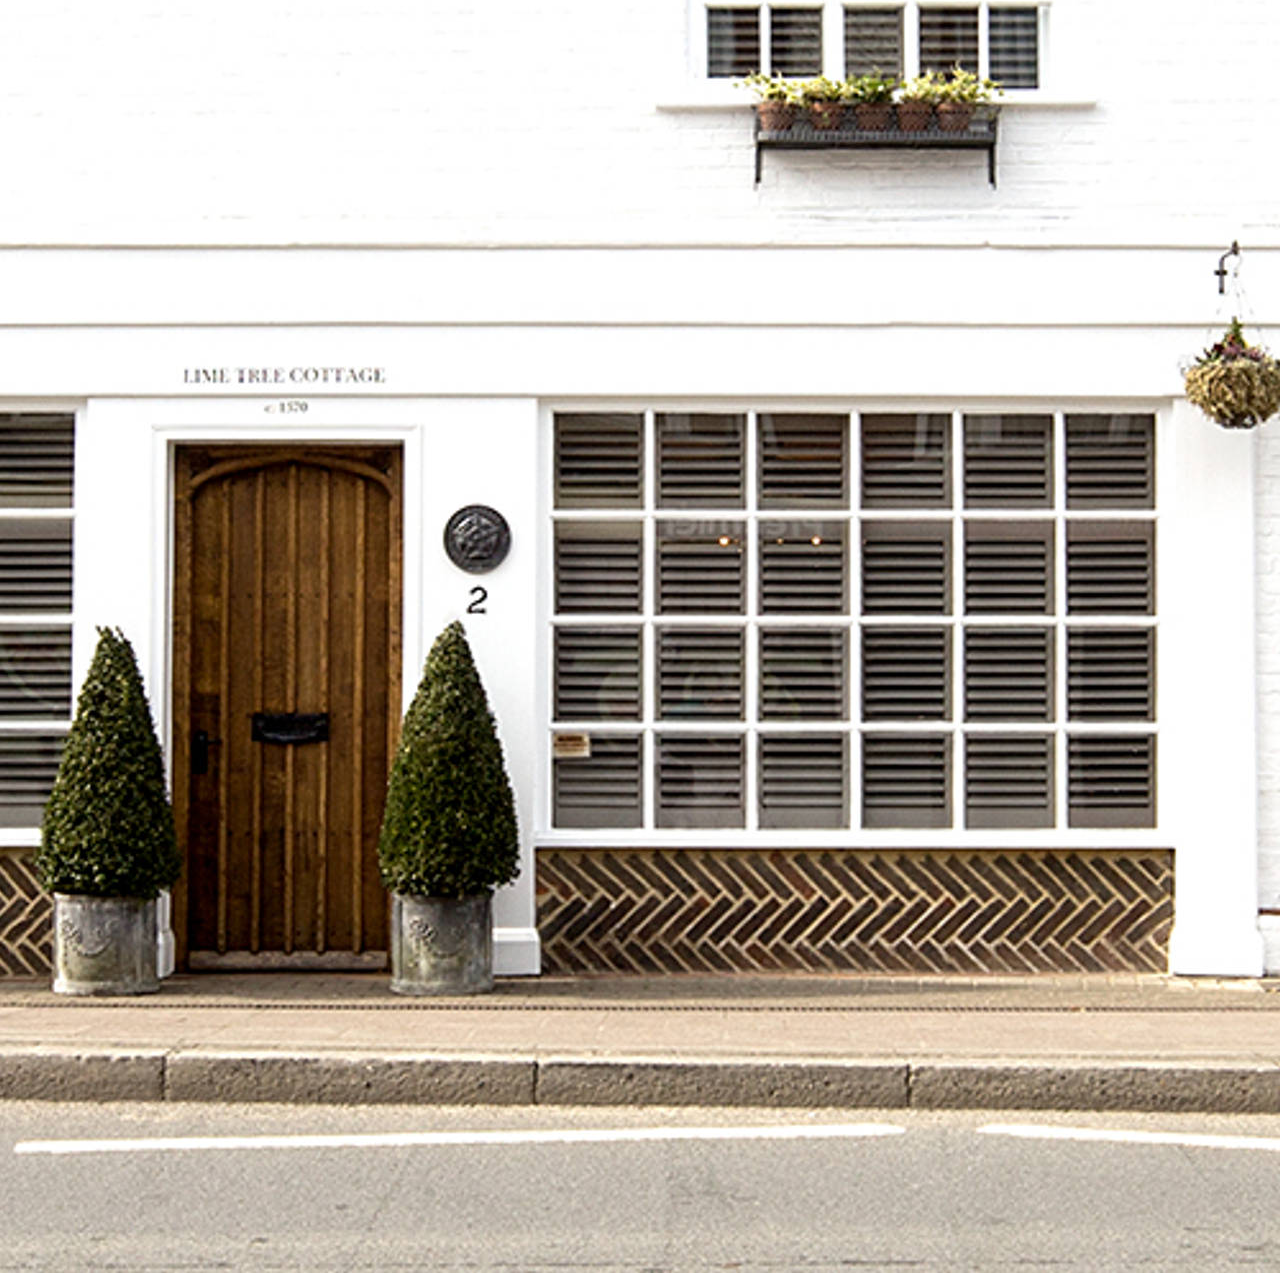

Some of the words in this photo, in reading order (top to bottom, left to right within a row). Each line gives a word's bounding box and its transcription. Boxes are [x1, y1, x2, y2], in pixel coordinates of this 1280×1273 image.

[183, 368, 231, 384] LIME
[235, 368, 286, 384] TREE
[289, 367, 387, 384] COTTAGE
[465, 584, 488, 614] 2
